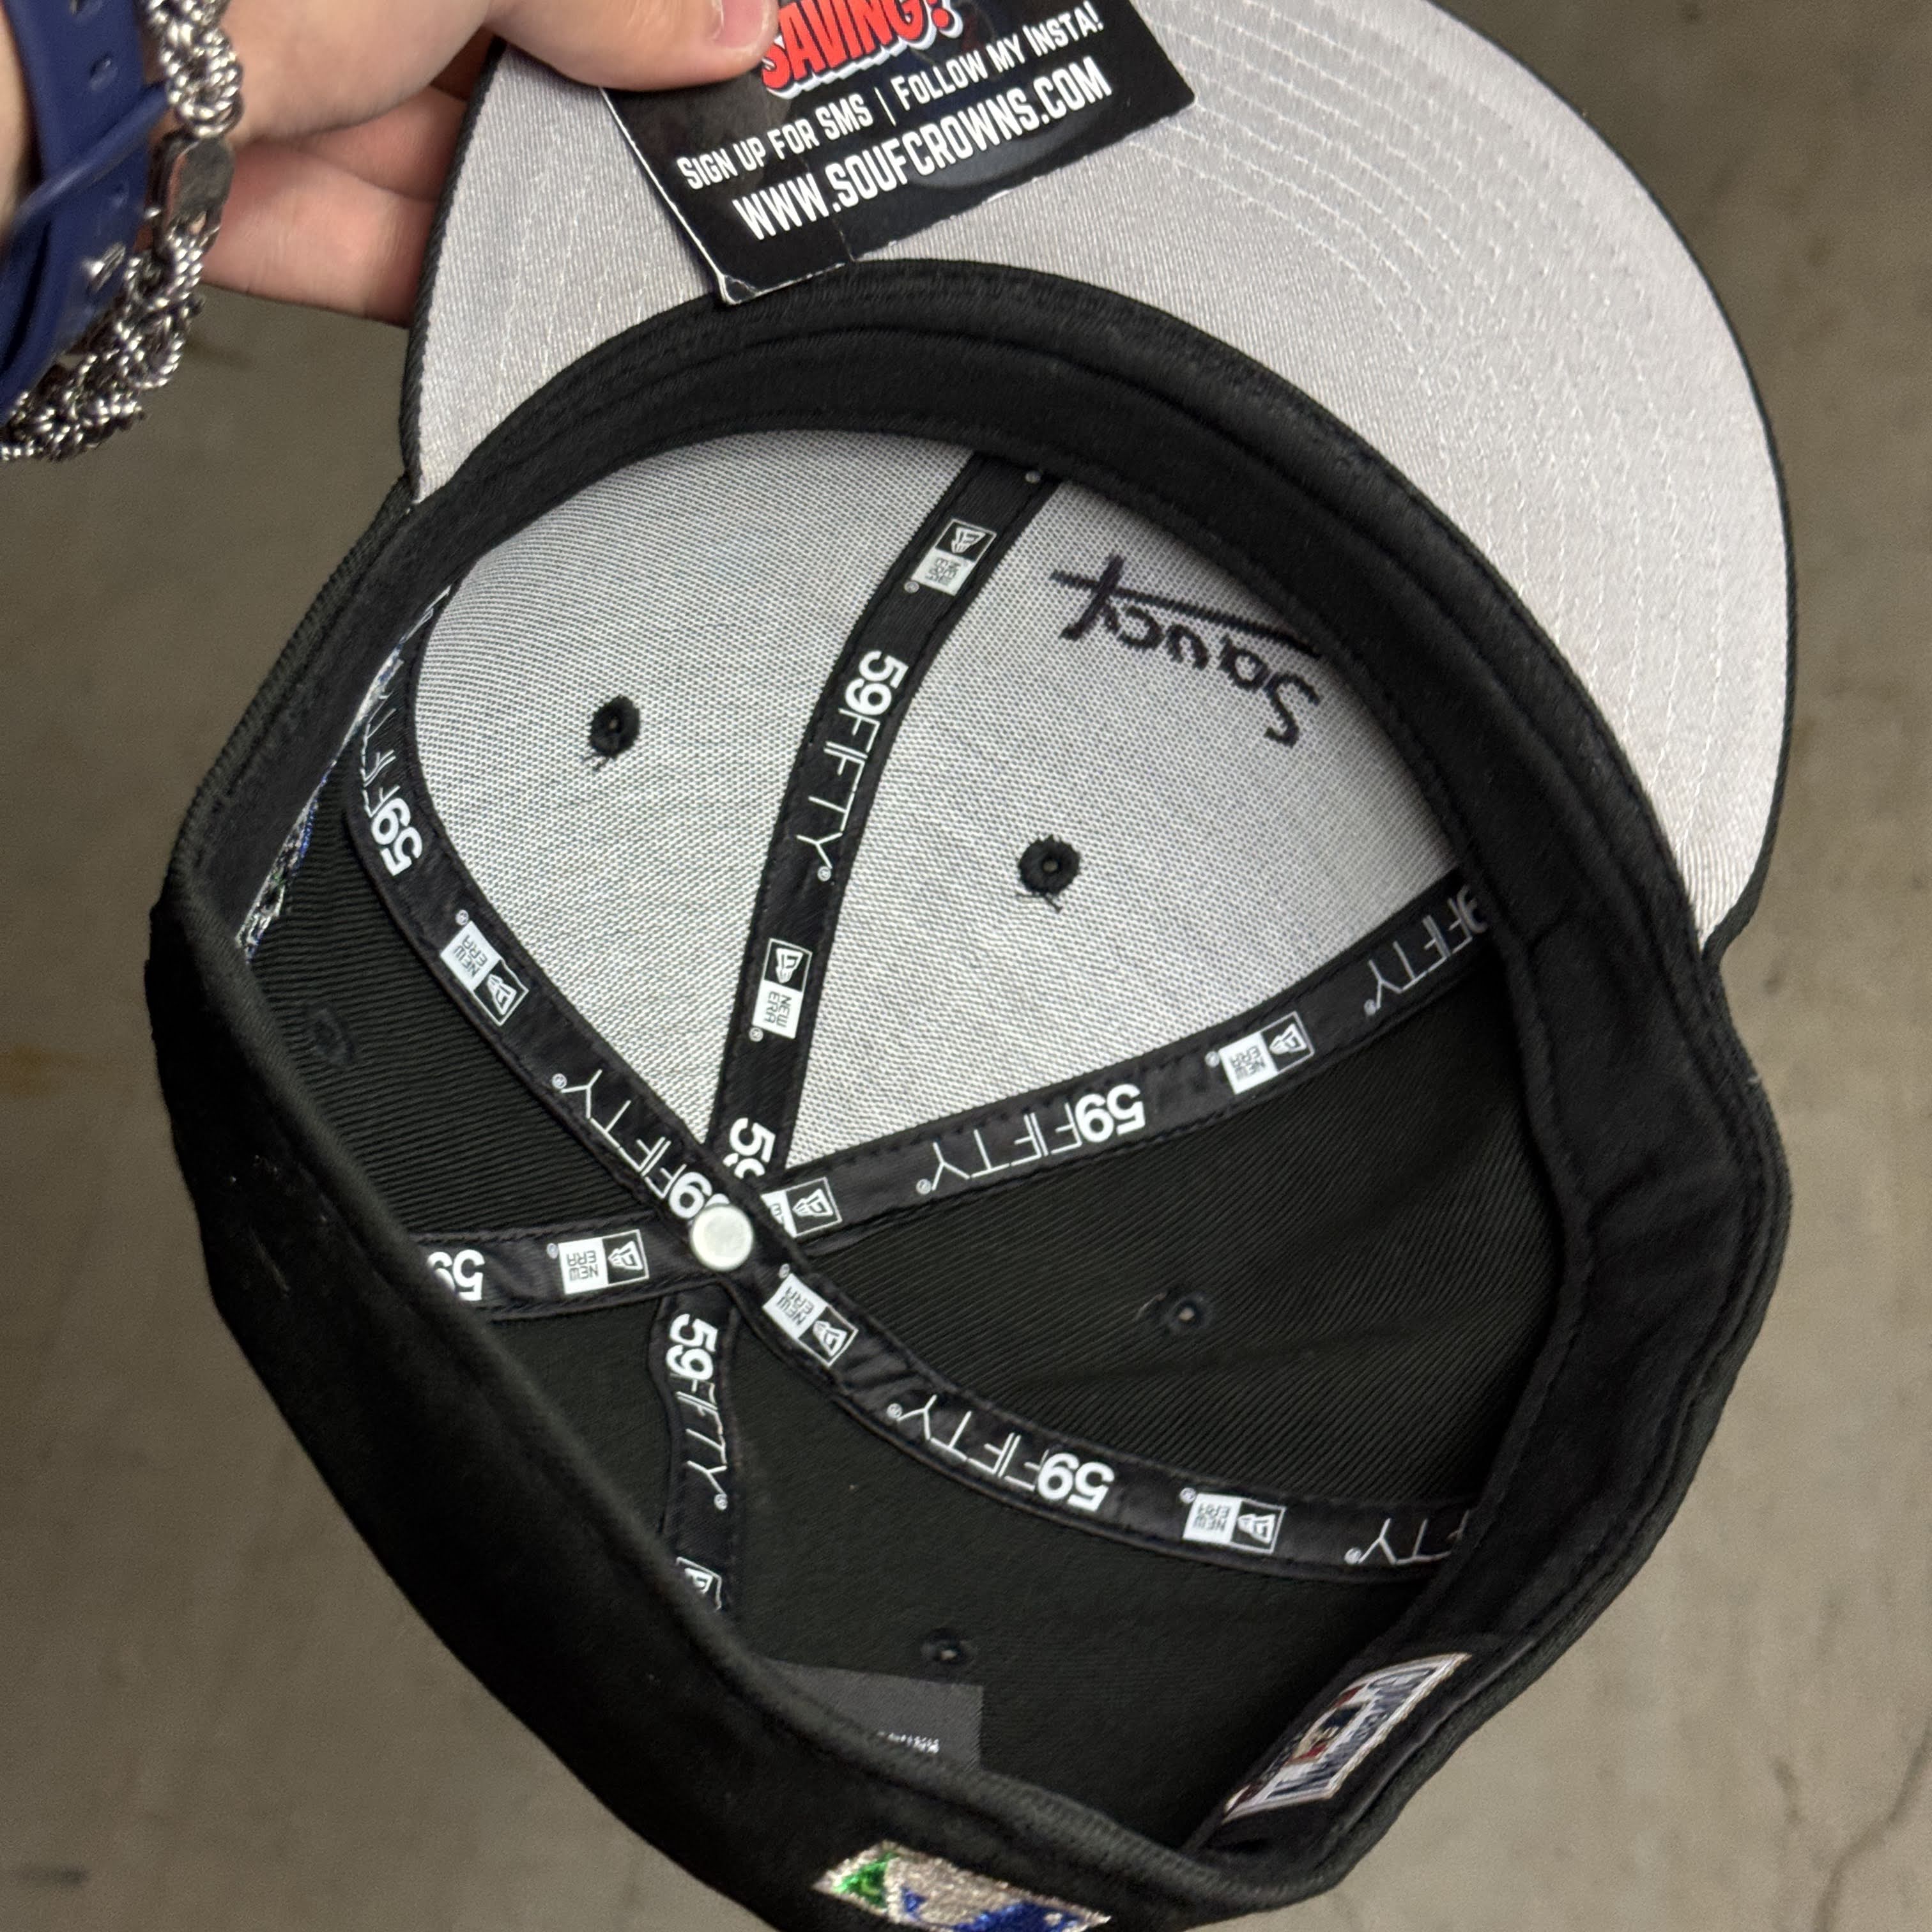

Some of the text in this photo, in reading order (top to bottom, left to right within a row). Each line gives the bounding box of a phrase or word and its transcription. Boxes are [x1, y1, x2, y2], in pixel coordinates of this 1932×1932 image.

[677, 148, 738, 188] SIGN
[733, 137, 766, 171] UP
[767, 119, 820, 159] FOR
[815, 94, 873, 140] SMS
[891, 50, 988, 111] FOLLOW
[986, 34, 1025, 72] MY
[1023, 1, 1103, 56] INSTA!
[732, 57, 1112, 240] WWW.SOUFCROWNS.COM
[763, 990, 781, 1024] ERA
[776, 993, 793, 1029] NEW
[560, 1070, 730, 1225] 9FIFTY
[566, 1250, 597, 1267] ERA
[569, 1263, 599, 1282] NEW
